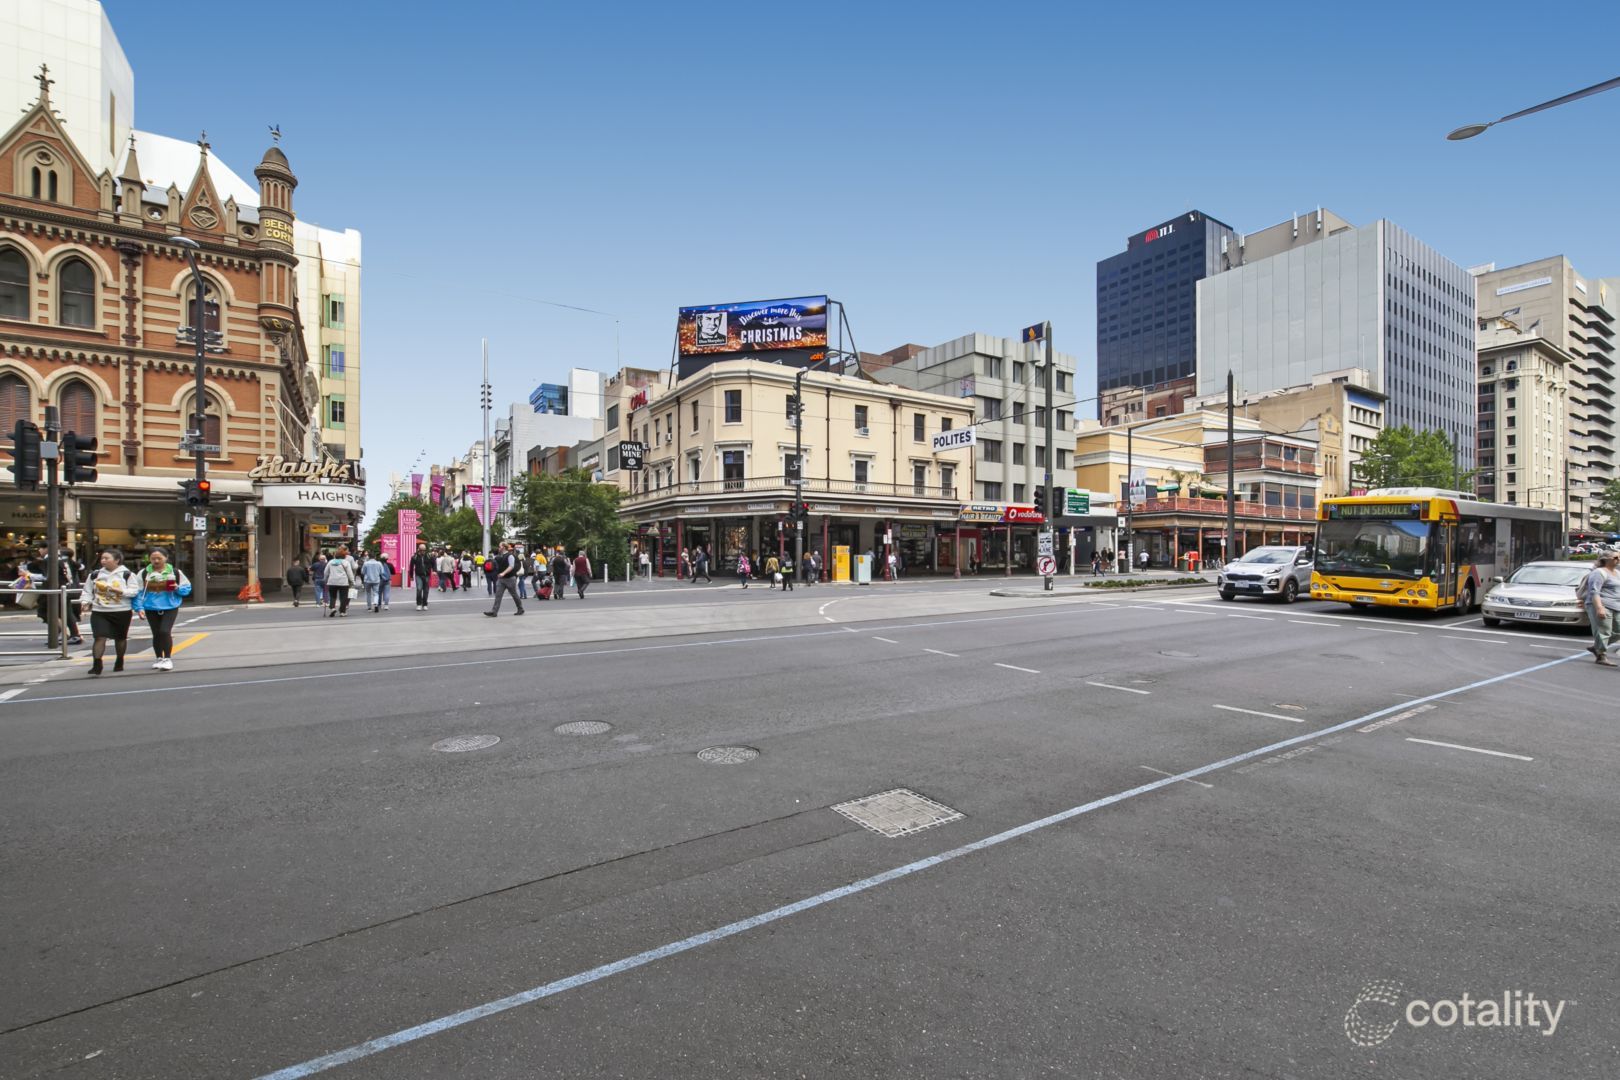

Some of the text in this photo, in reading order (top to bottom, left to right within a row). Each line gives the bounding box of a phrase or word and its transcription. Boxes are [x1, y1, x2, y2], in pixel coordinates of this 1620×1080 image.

[739, 307, 802, 326] Discover more this
[741, 326, 802, 343] CHRISTMAS
[933, 430, 972, 448] POLITES
[621, 443, 642, 451] OPAL
[622, 450, 642, 458] MINE
[297, 490, 354, 503] HAIGH'S
[1018, 510, 1043, 518] vodafone
[1359, 505, 1370, 514] IN
